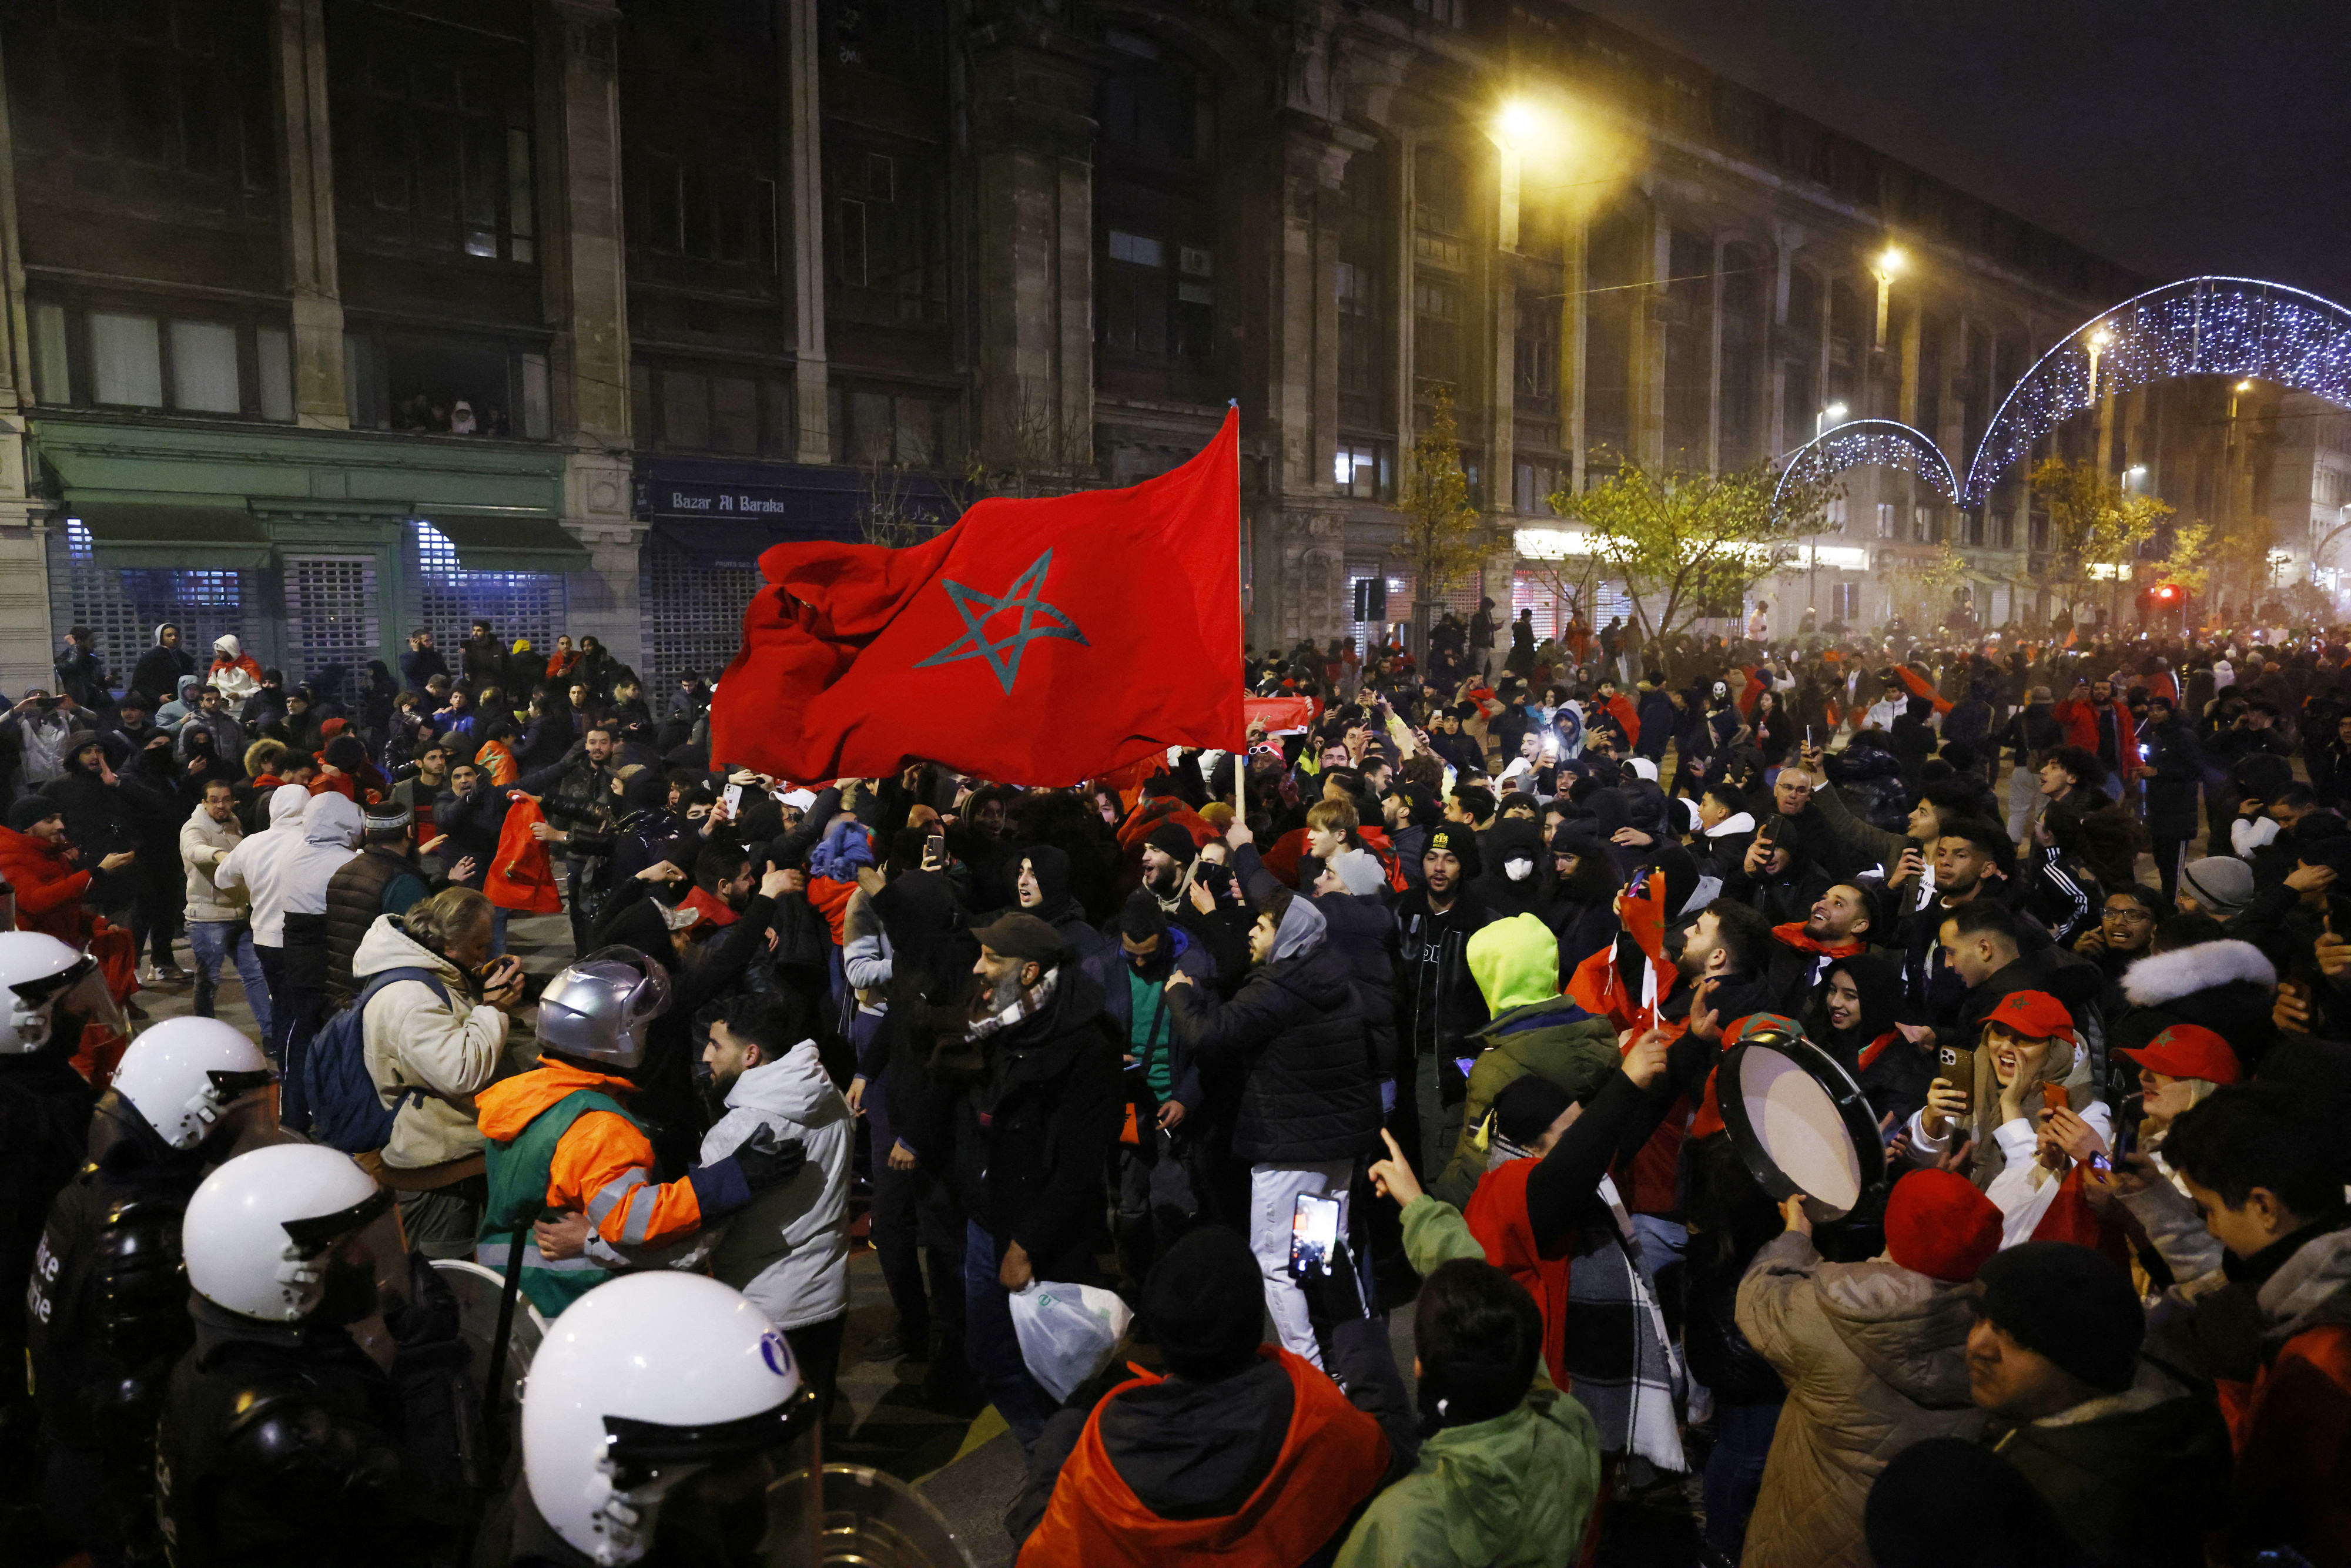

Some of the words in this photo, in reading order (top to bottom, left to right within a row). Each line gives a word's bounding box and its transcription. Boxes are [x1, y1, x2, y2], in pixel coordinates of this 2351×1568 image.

[673, 492, 711, 509] Bazar
[719, 495, 733, 510] Al
[740, 496, 784, 512] Baraka
